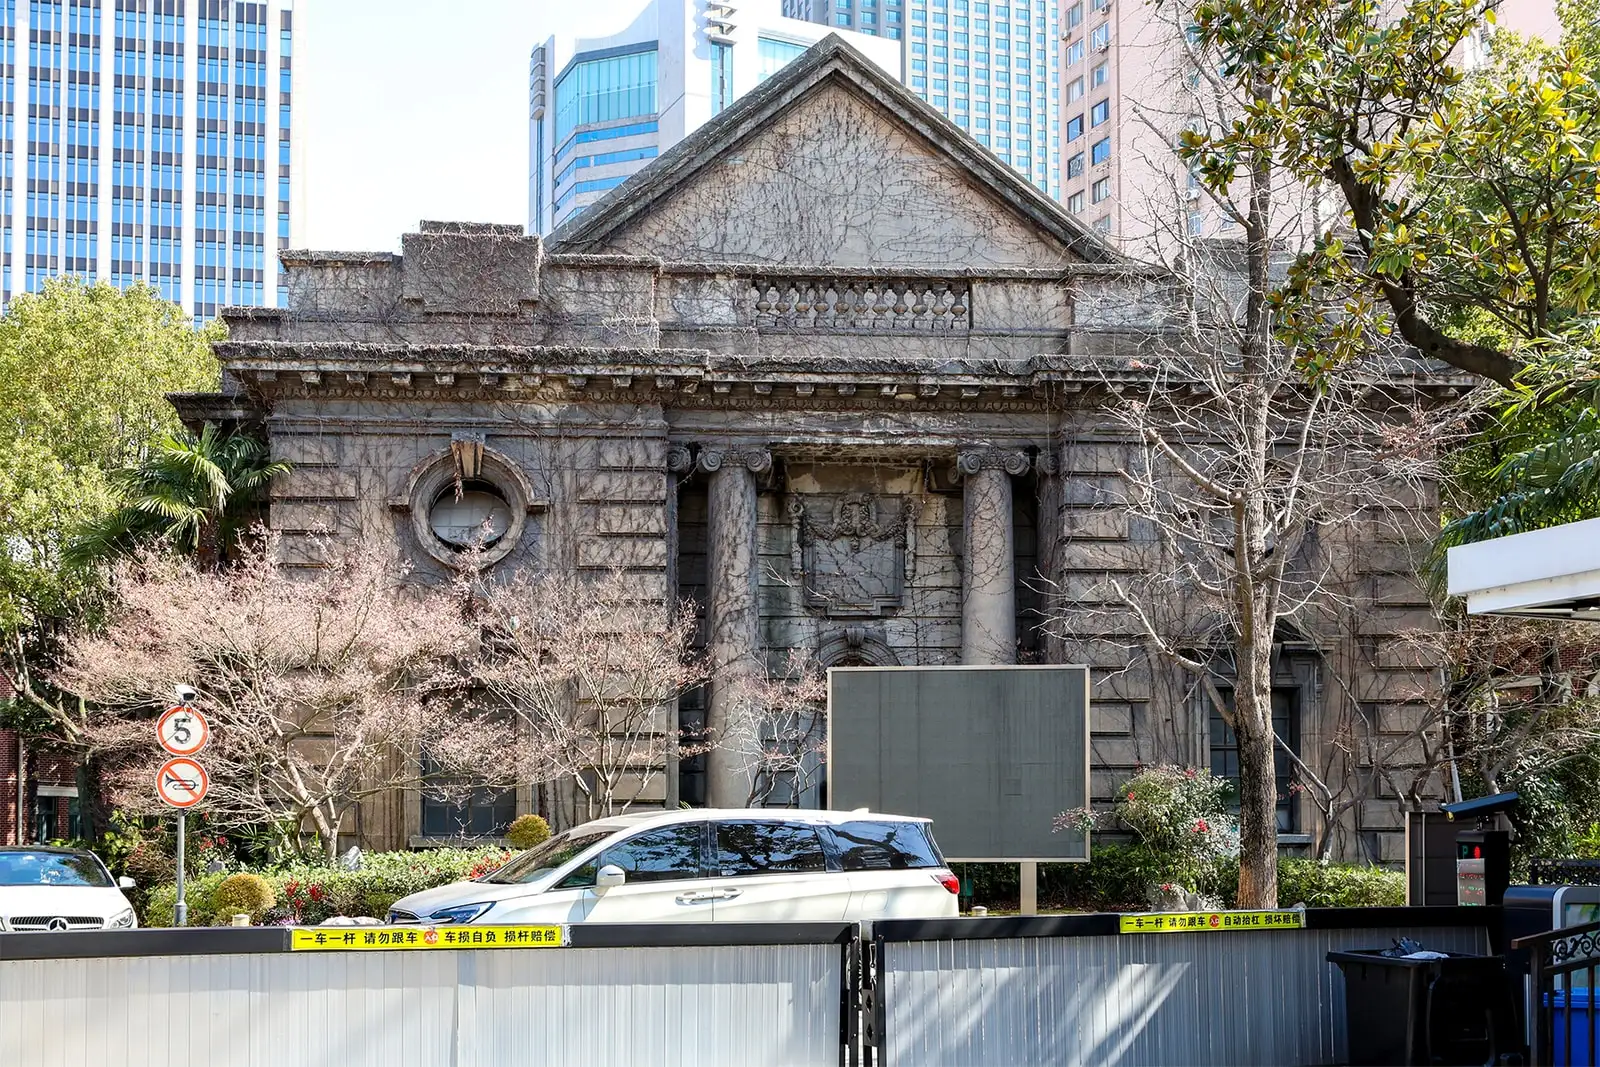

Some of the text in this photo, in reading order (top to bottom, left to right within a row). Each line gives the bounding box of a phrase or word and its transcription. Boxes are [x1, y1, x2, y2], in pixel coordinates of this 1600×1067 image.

[174, 718, 192, 744] 5
[1125, 917, 1163, 928] 一车一杆
[1168, 916, 1206, 927] 请勿跟车
[1265, 914, 1300, 925] 损坏赔偿
[300, 932, 356, 945] 一车一杆
[364, 931, 418, 944] 请勿跟车
[445, 931, 497, 943] 车损自负
[504, 929, 556, 942] 损杆赔偿
